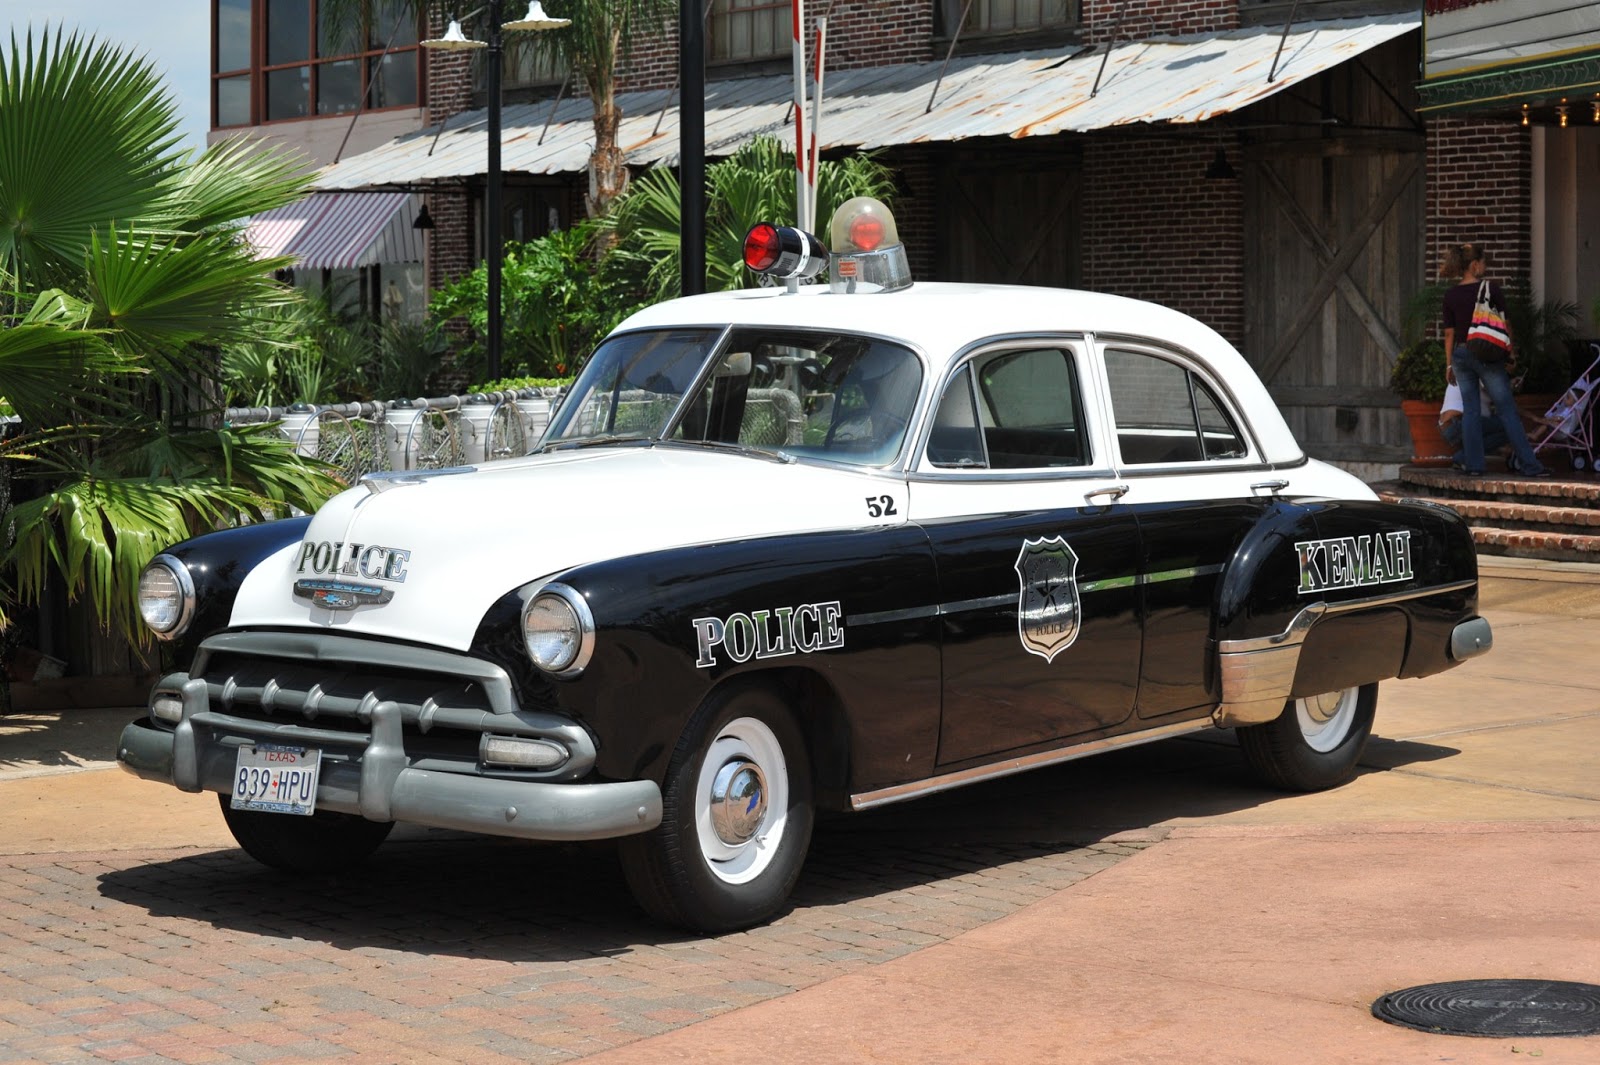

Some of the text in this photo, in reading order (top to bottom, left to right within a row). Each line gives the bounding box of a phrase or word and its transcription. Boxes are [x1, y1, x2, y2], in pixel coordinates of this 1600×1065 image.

[865, 495, 897, 518] 52
[296, 541, 411, 583] POLICE
[1294, 530, 1414, 594] KEMAH
[692, 600, 844, 668] POLICE
[1036, 622, 1065, 637] POLICE
[237, 767, 312, 801] 839 HPU
